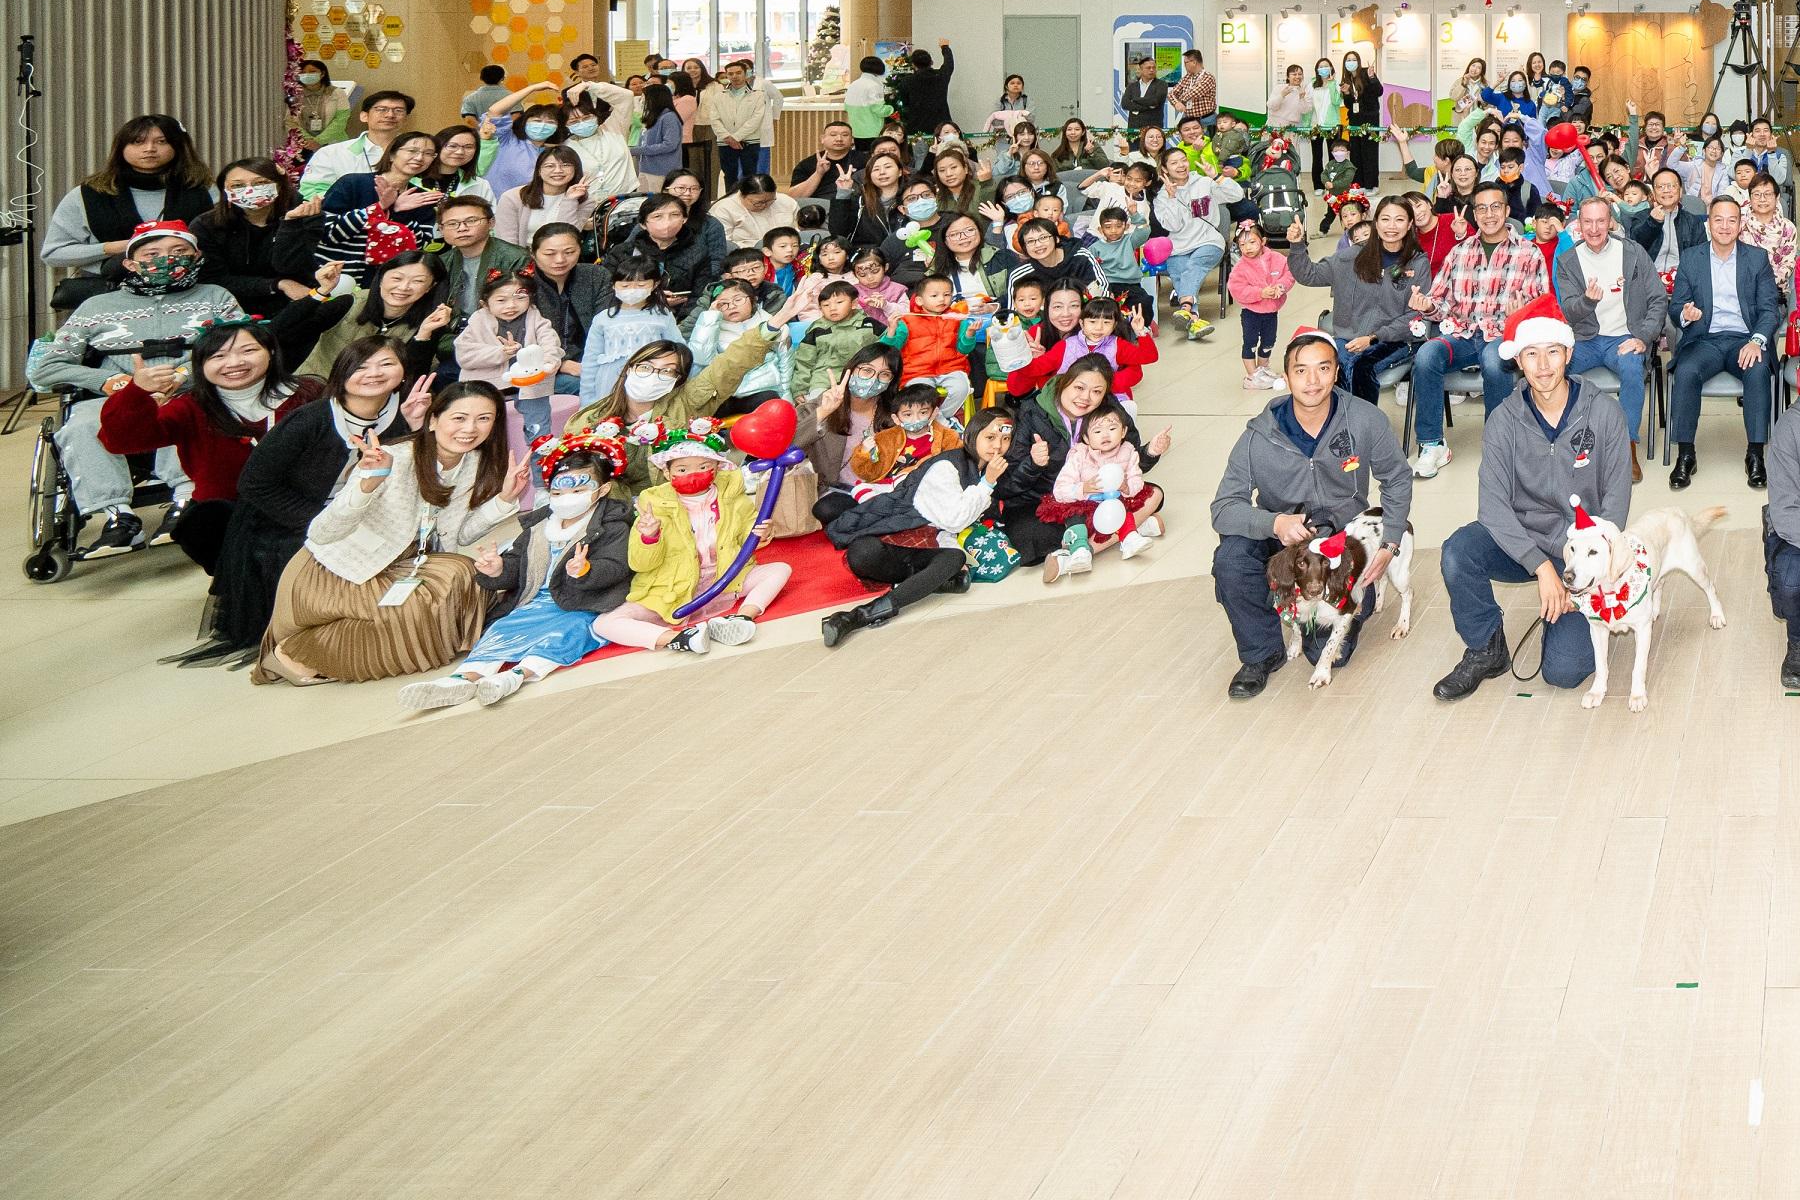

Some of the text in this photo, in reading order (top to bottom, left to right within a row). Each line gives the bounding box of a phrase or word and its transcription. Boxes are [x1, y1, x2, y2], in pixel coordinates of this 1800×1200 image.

[1221, 22, 1250, 44] B1
[1330, 22, 1345, 44] 1
[1385, 22, 1399, 43] 2
[1440, 21, 1454, 44] 3
[1495, 21, 1509, 44] 4
